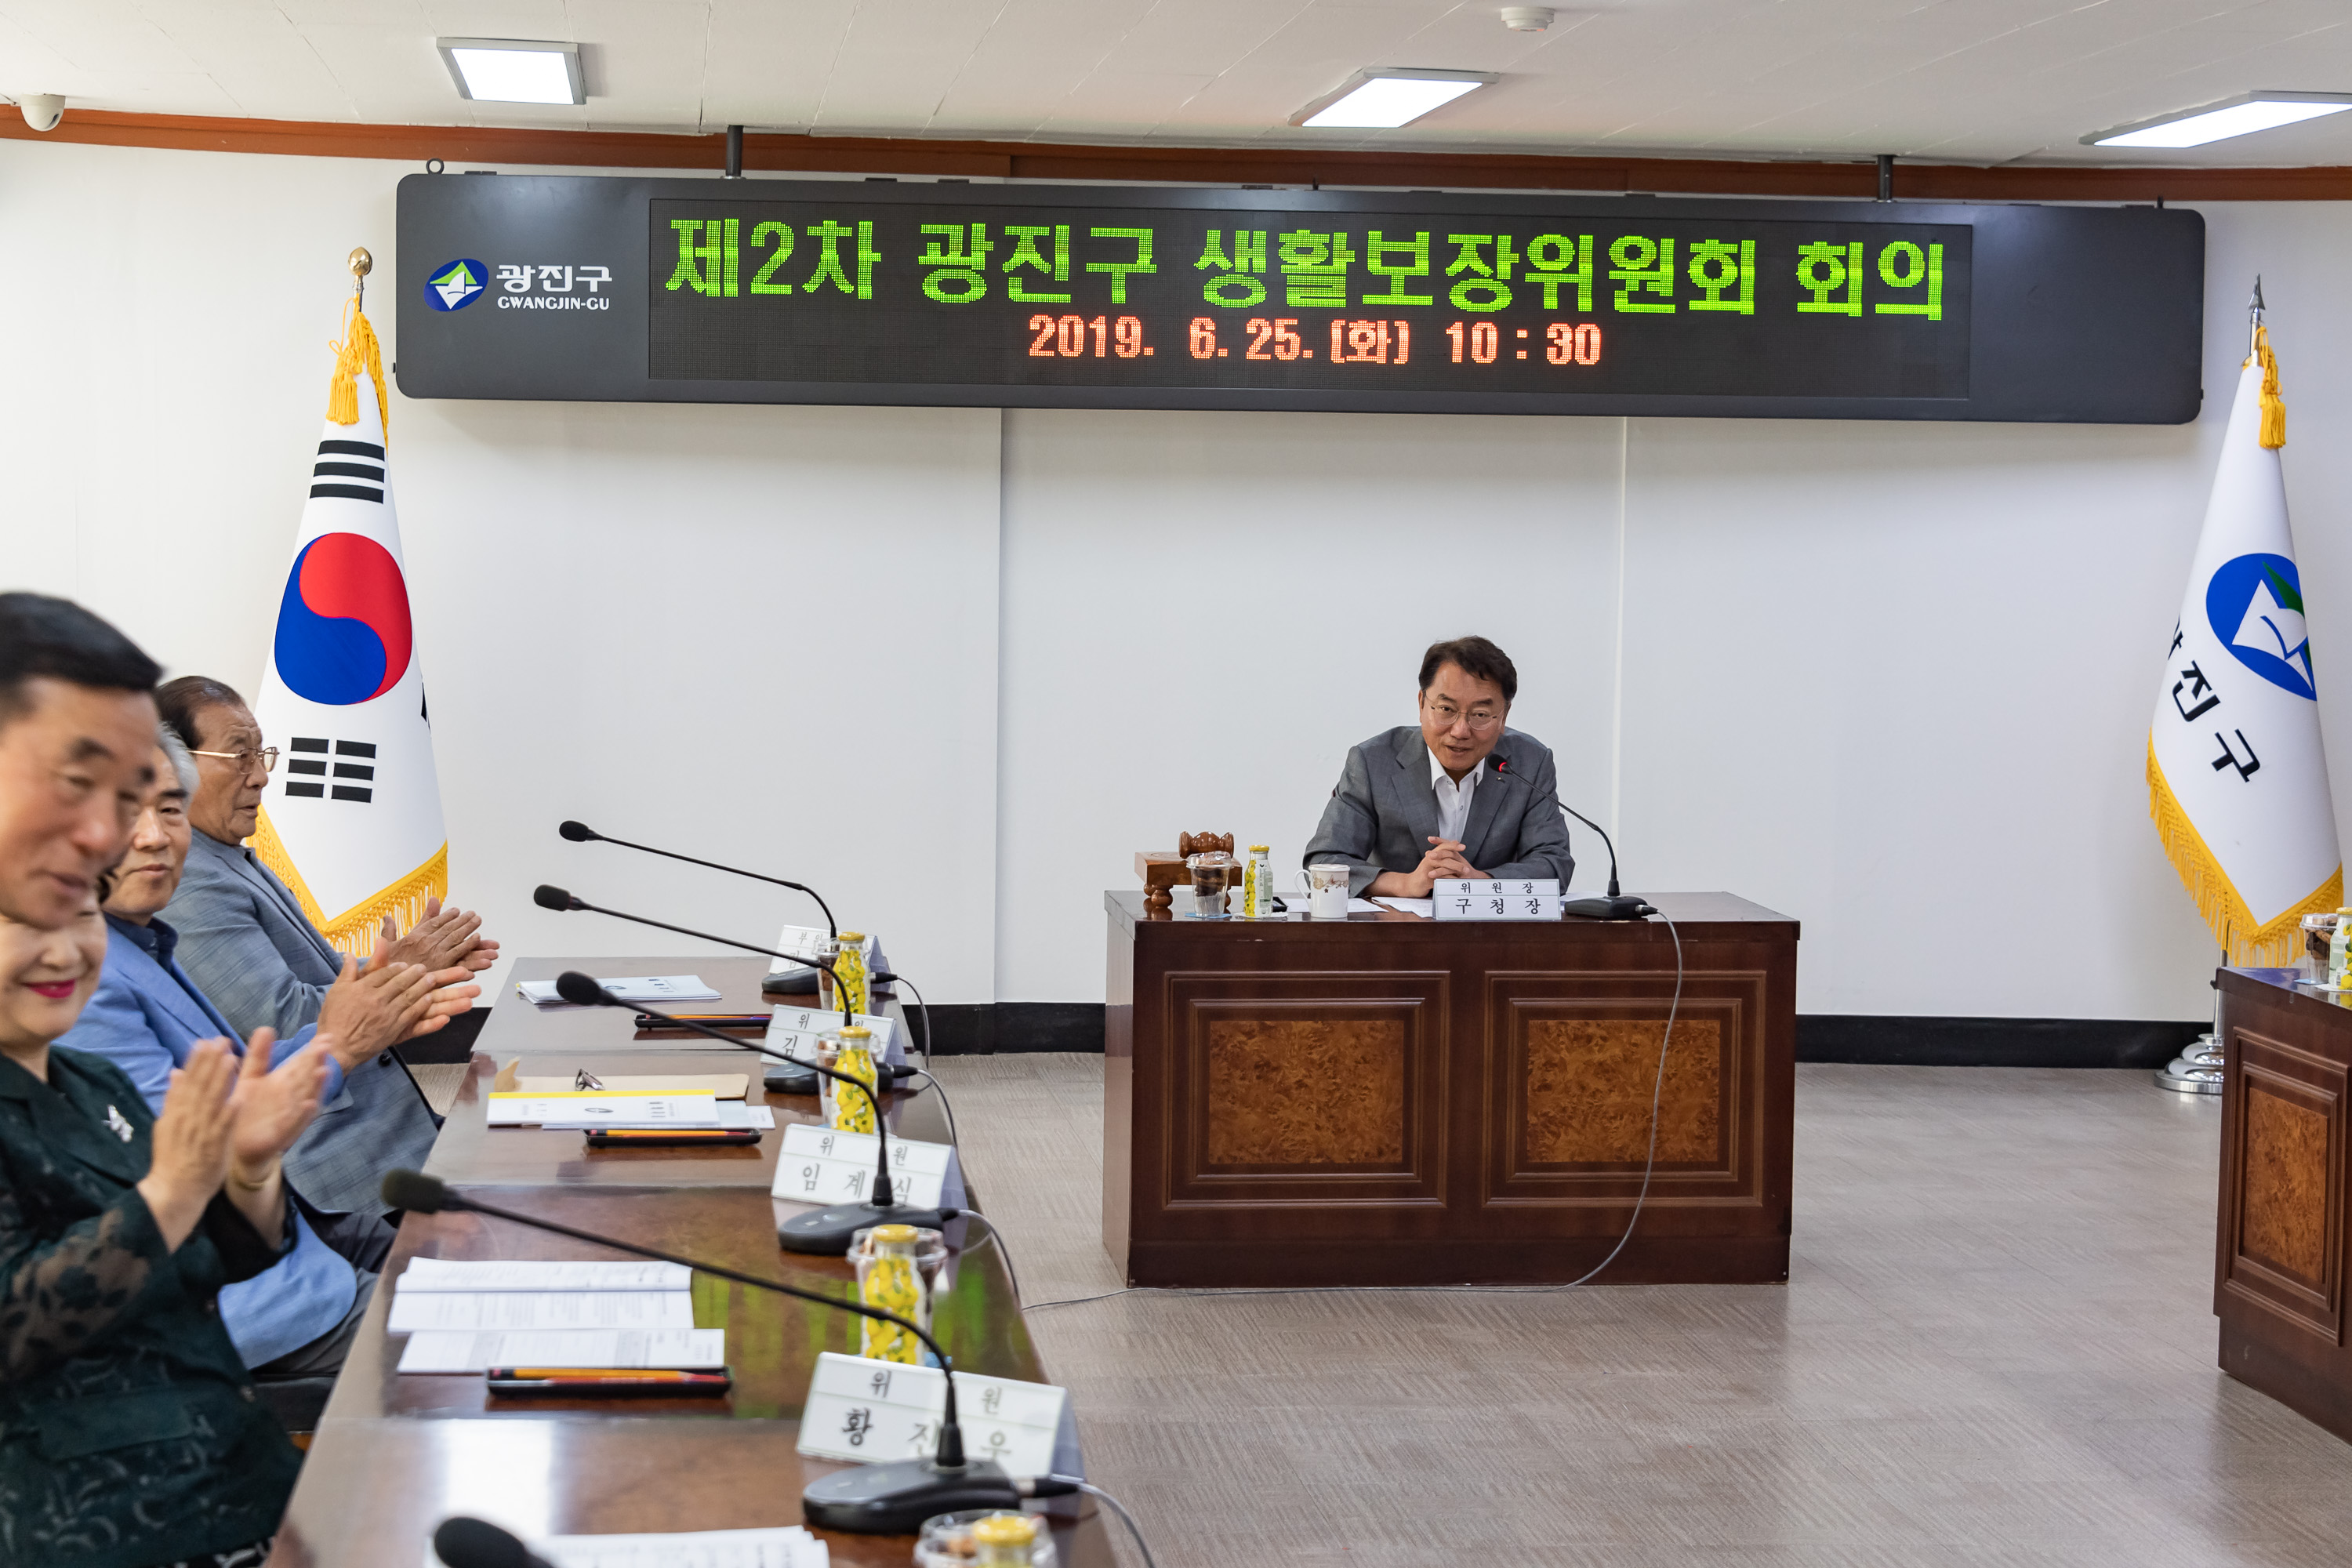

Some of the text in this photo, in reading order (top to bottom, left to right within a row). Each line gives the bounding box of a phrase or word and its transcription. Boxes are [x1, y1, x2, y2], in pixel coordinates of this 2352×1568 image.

[495, 264, 613, 293] 광진구
[665, 218, 1944, 321] 제2차 광진구 생활보장위원회 회의
[497, 296, 609, 310] GWANGJIN-GU
[1029, 314, 1154, 358] 2019.
[1189, 316, 1229, 359] 6.
[1246, 318, 1313, 361] 25.
